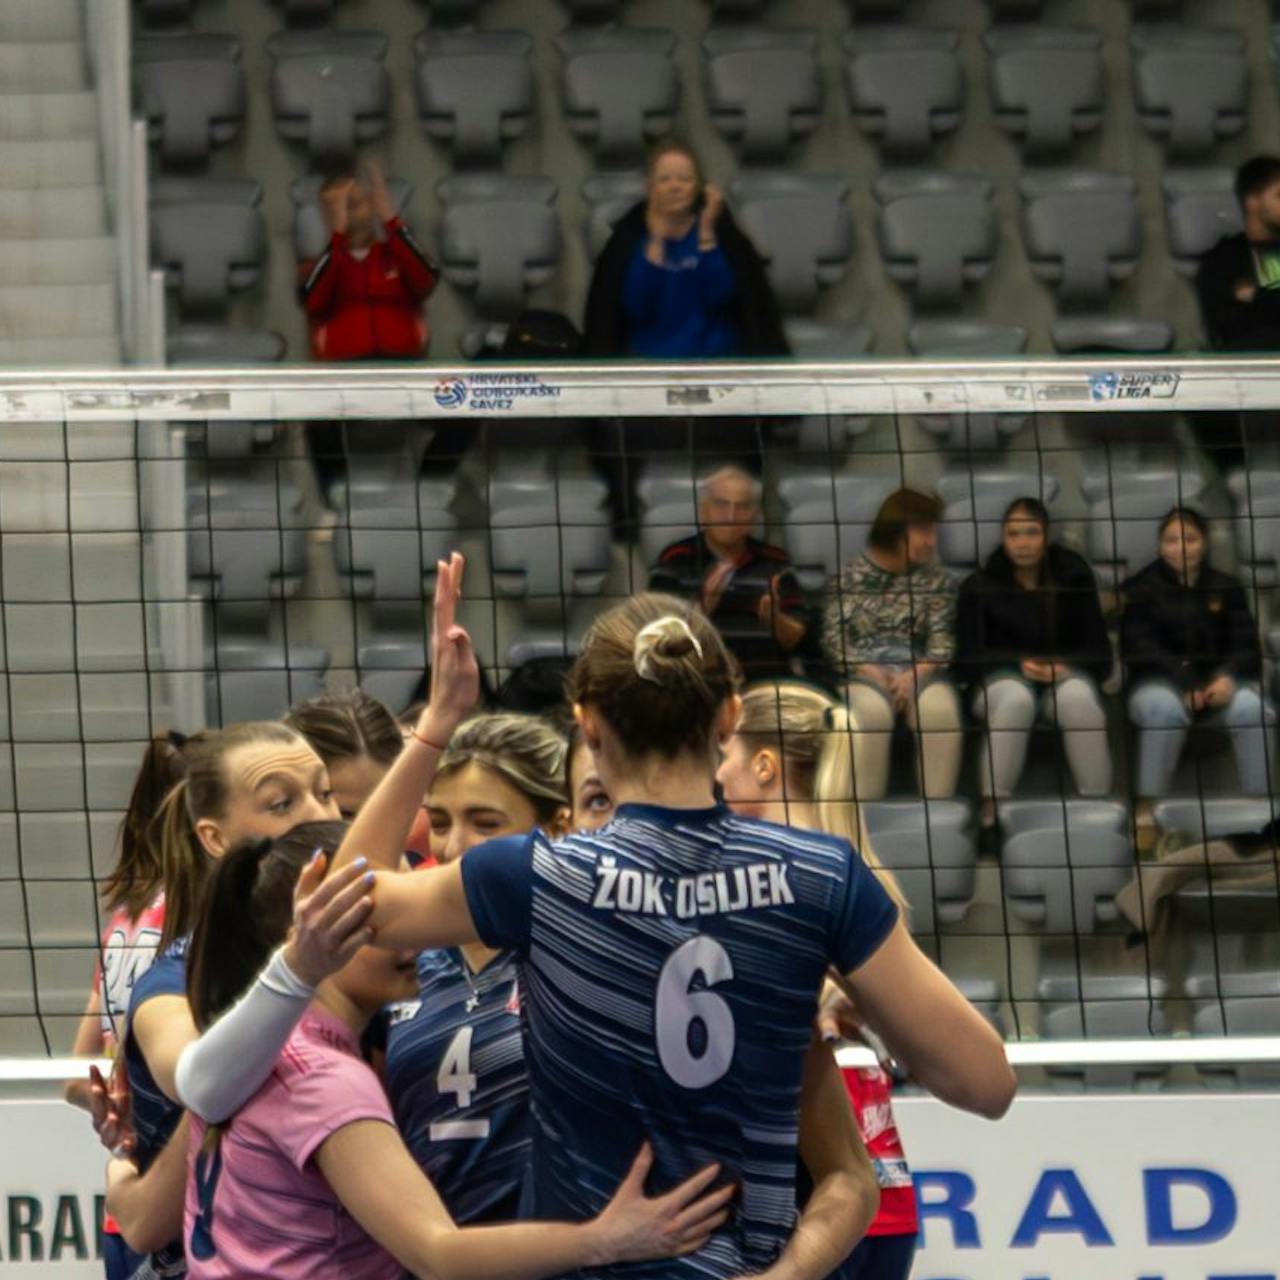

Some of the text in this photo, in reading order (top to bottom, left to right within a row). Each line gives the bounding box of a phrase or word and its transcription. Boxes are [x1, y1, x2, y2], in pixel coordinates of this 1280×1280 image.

[469, 399, 513, 410] SAVEZ
[1117, 386, 1151, 399] LIGA
[1119, 374, 1172, 386] SUPER
[593, 859, 795, 919] ŽOK OSIJEK
[655, 935, 736, 1090] 6
[436, 1026, 478, 1108] 4
[911, 1168, 1239, 1250] RAD
